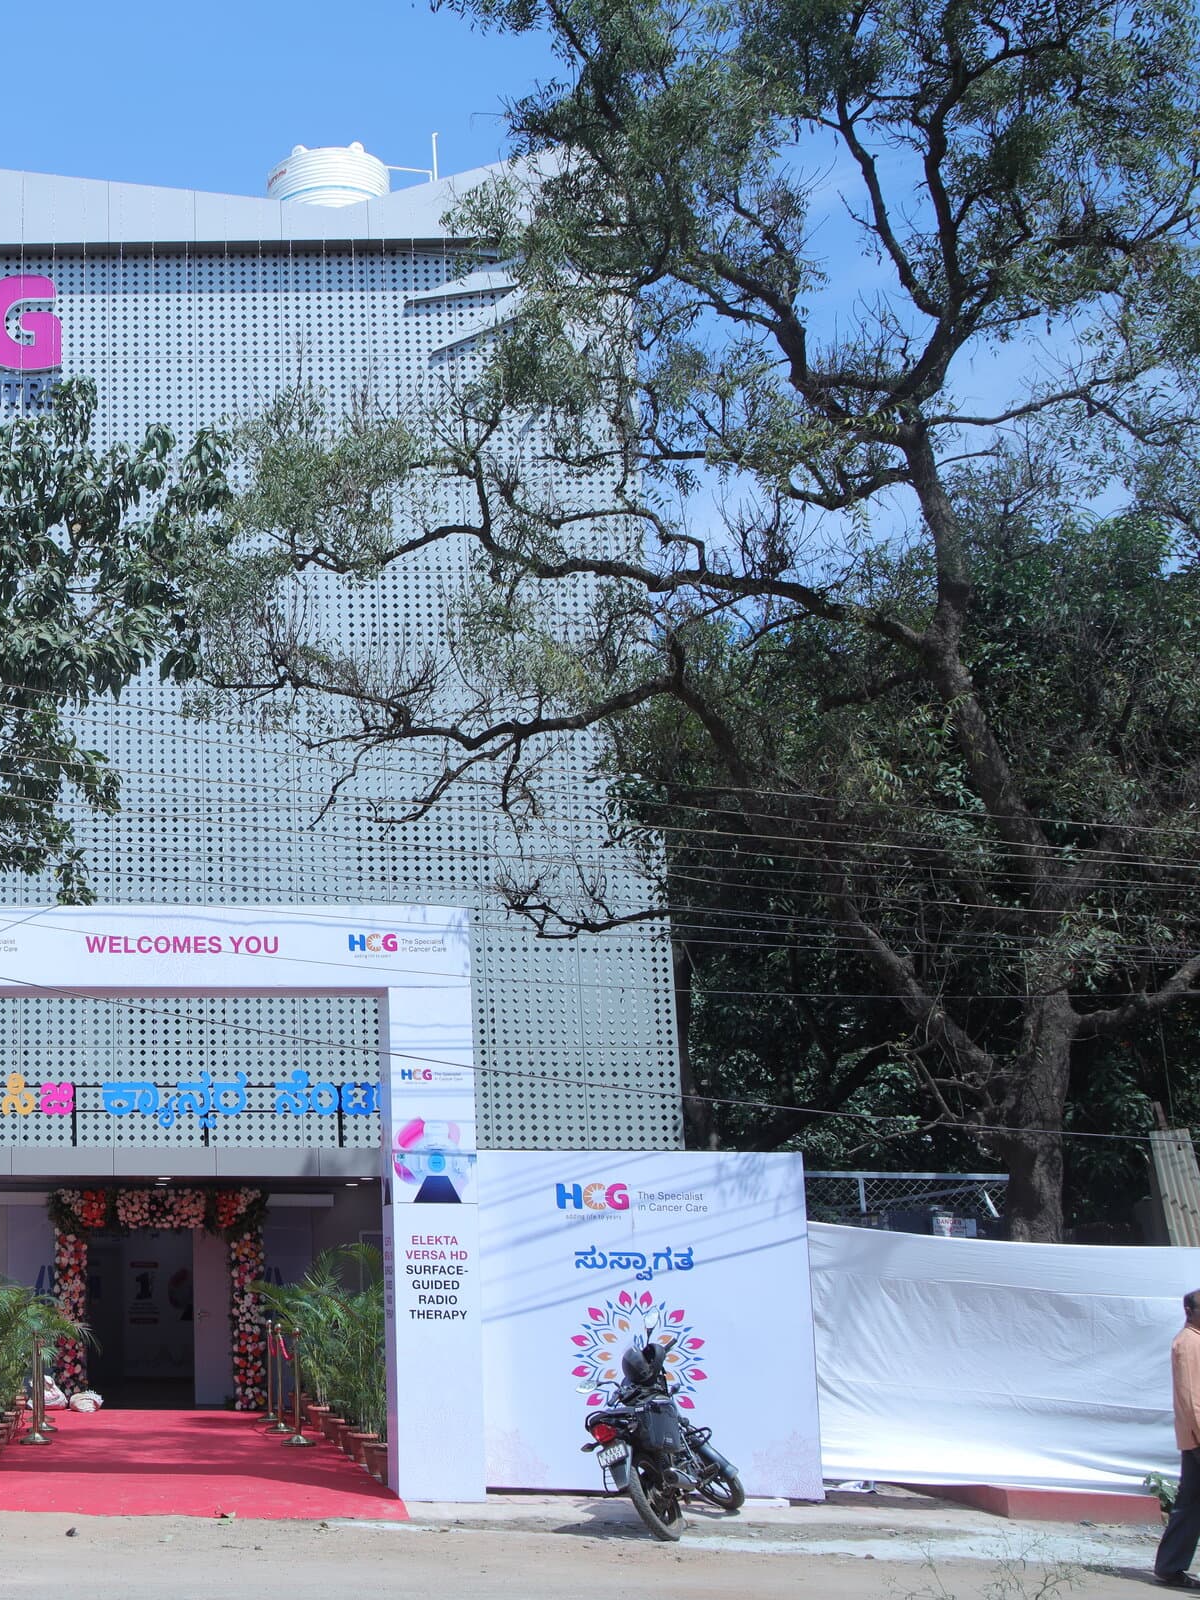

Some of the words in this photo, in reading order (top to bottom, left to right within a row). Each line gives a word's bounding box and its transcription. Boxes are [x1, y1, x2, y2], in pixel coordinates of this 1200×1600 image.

[86, 935, 222, 954] WELCOMES
[229, 936, 279, 954] YOU
[348, 933, 398, 952] HCG
[401, 1068, 433, 1080] HCG
[556, 1183, 630, 1210] HCG
[638, 1191, 656, 1200] The
[657, 1192, 703, 1202] Specialist
[638, 1202, 646, 1211] in
[648, 1203, 682, 1212] Cancer
[685, 1204, 708, 1212] Care
[411, 1235, 458, 1245] ELEKTA
[406, 1250, 446, 1260] VERSA
[450, 1250, 468, 1260] HD
[574, 1245, 694, 1281] ಸುಸ್ವಾಗತ
[406, 1265, 469, 1275] SURFACE-
[412, 1280, 460, 1290] GUIDED
[418, 1295, 458, 1305] RADIO
[409, 1309, 467, 1320] THERAPY
